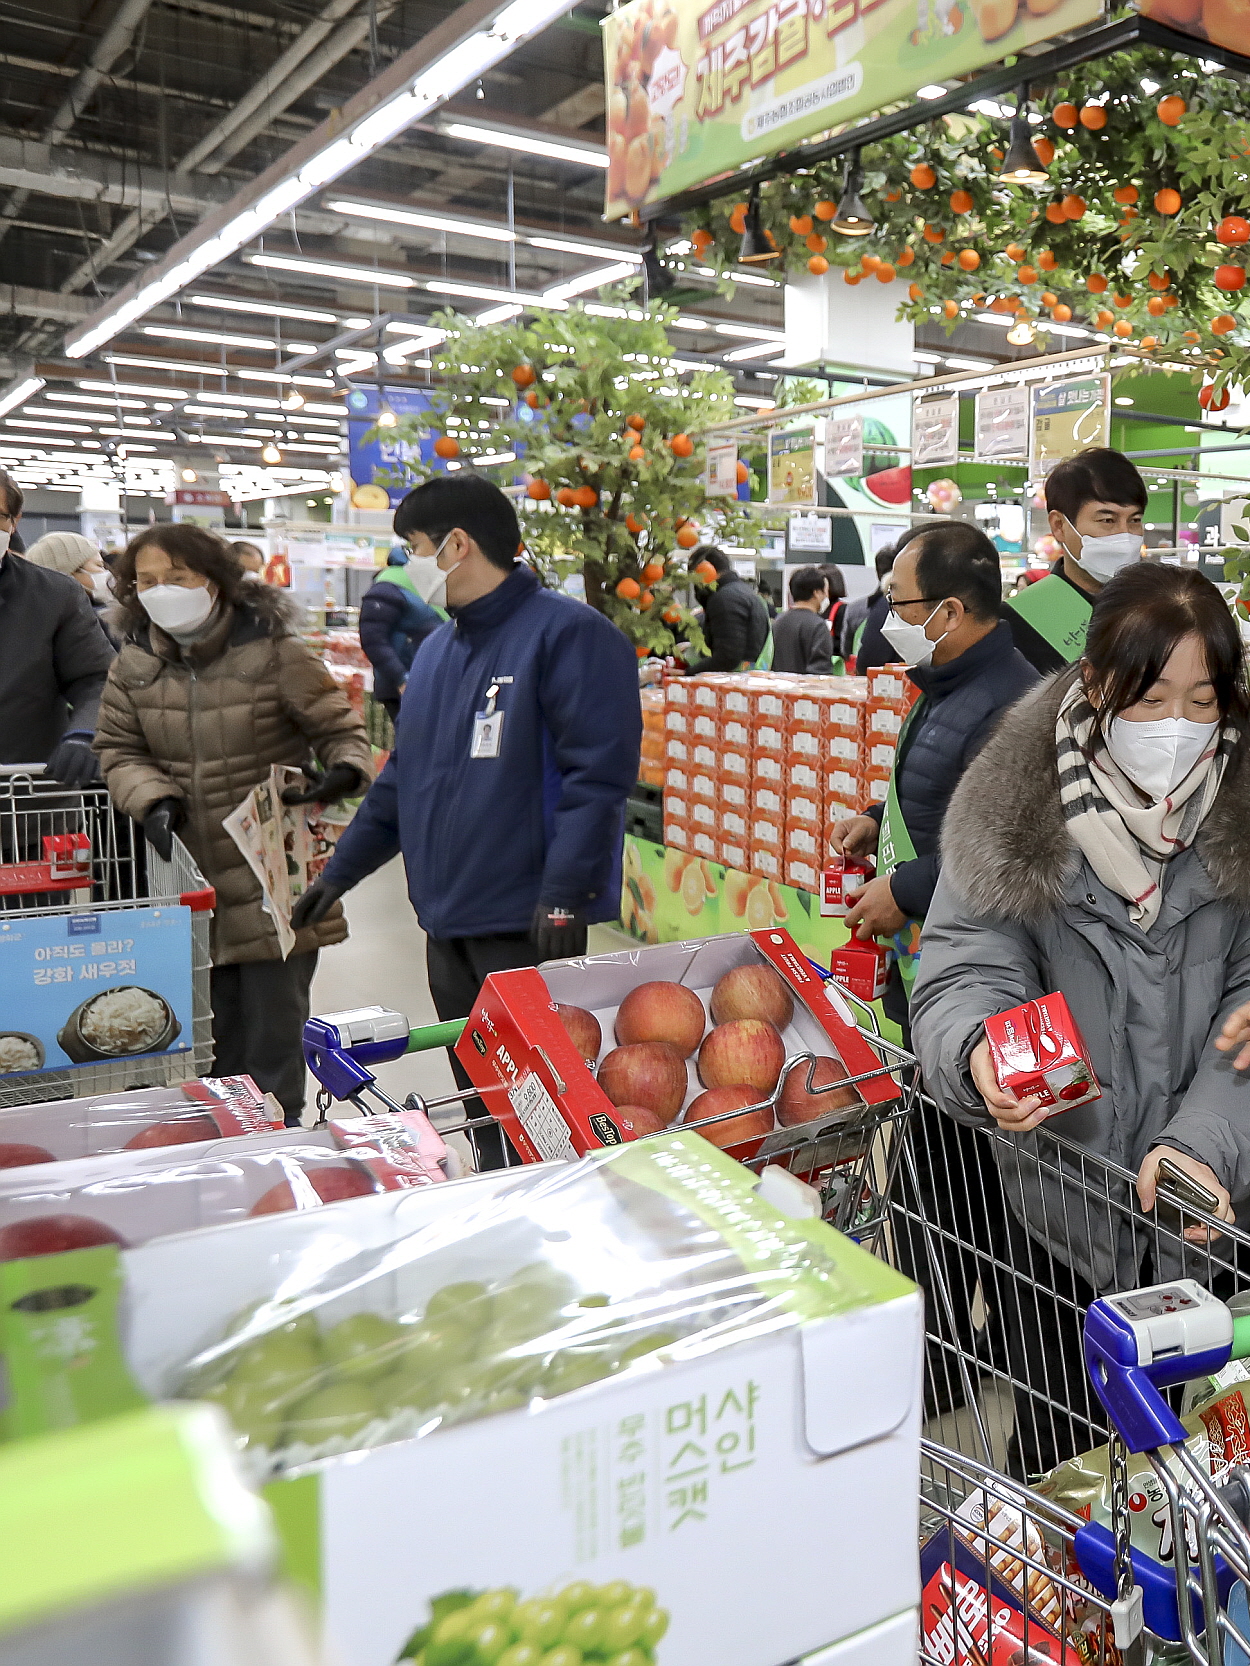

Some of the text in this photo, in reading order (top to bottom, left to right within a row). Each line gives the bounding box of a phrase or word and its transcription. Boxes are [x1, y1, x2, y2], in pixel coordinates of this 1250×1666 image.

[825, 886, 841, 894] APPLE
[34, 943, 86, 961] 아직도
[33, 959, 137, 986] 강화 새우젓
[595, 1114, 618, 1146] BesTop
[714, 1379, 760, 1475] 샤인
